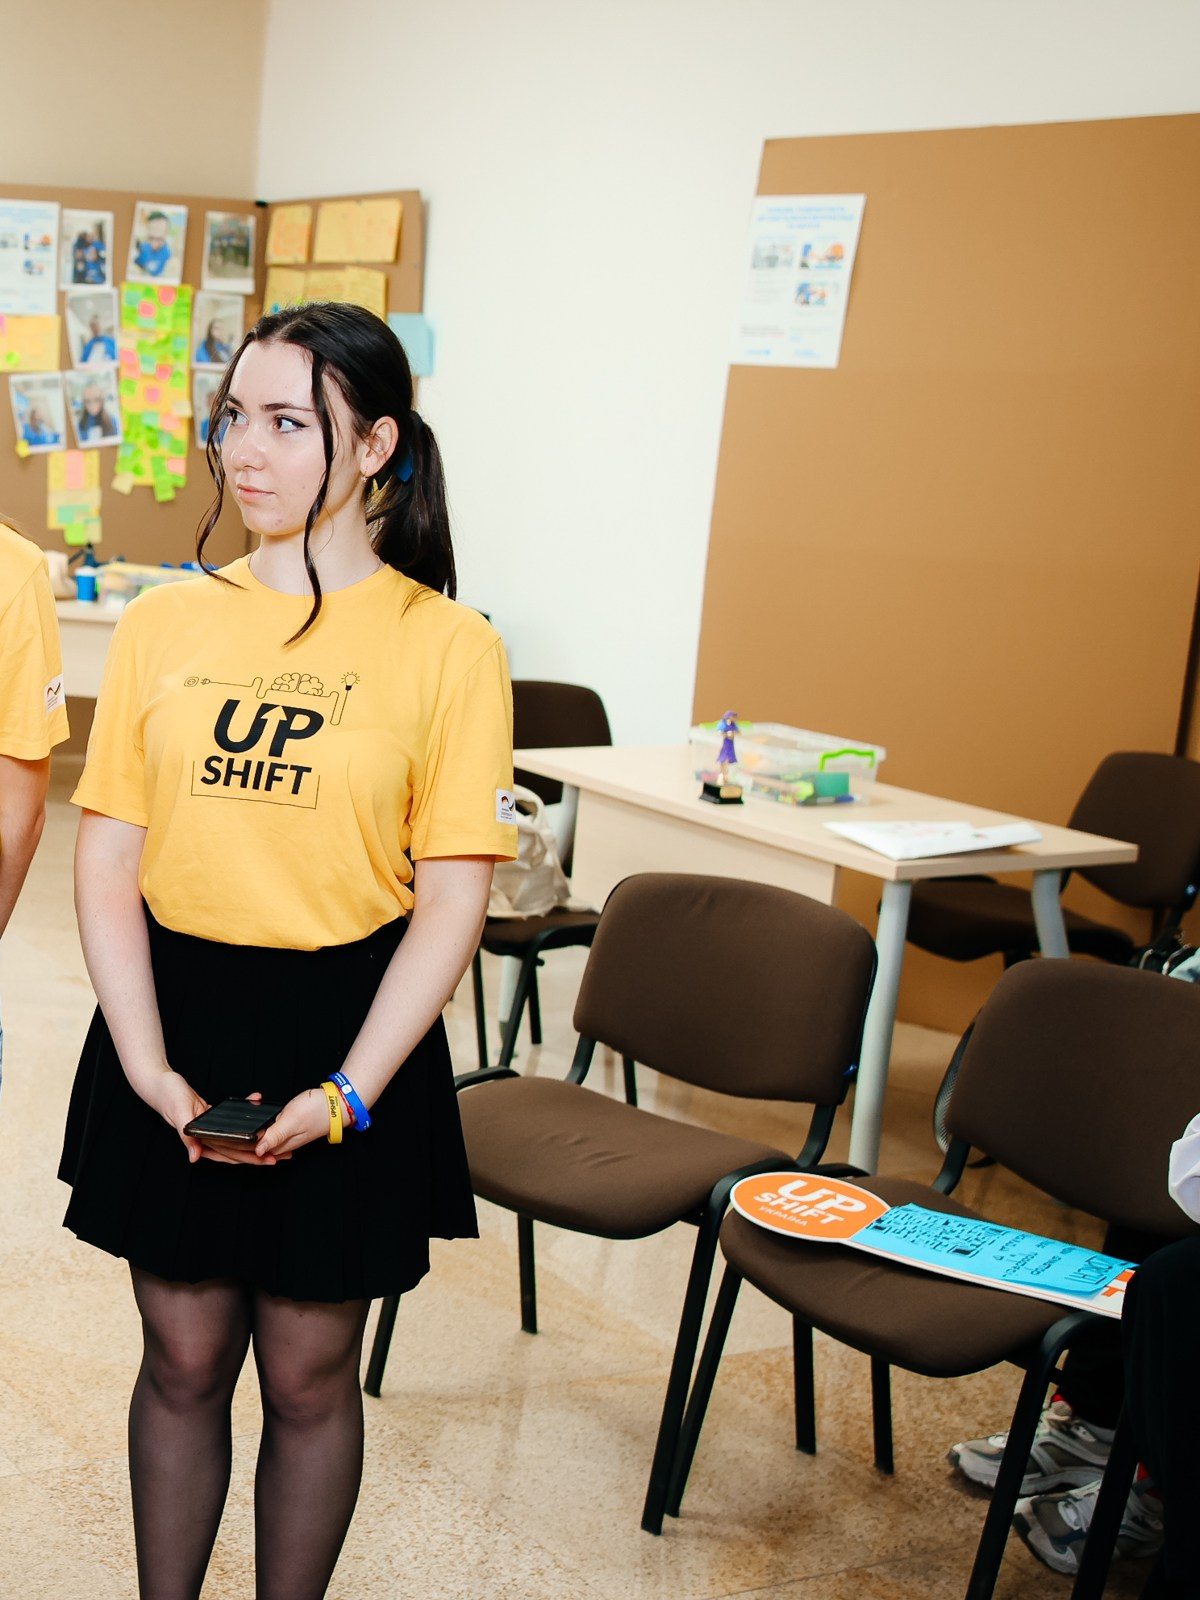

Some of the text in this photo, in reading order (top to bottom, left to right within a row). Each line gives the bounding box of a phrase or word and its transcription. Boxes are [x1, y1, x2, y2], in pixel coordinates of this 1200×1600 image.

[213, 698, 324, 758] UP
[200, 755, 312, 795] SHIFT
[753, 1192, 845, 1224] SHIFT
[778, 1179, 867, 1212] UP
